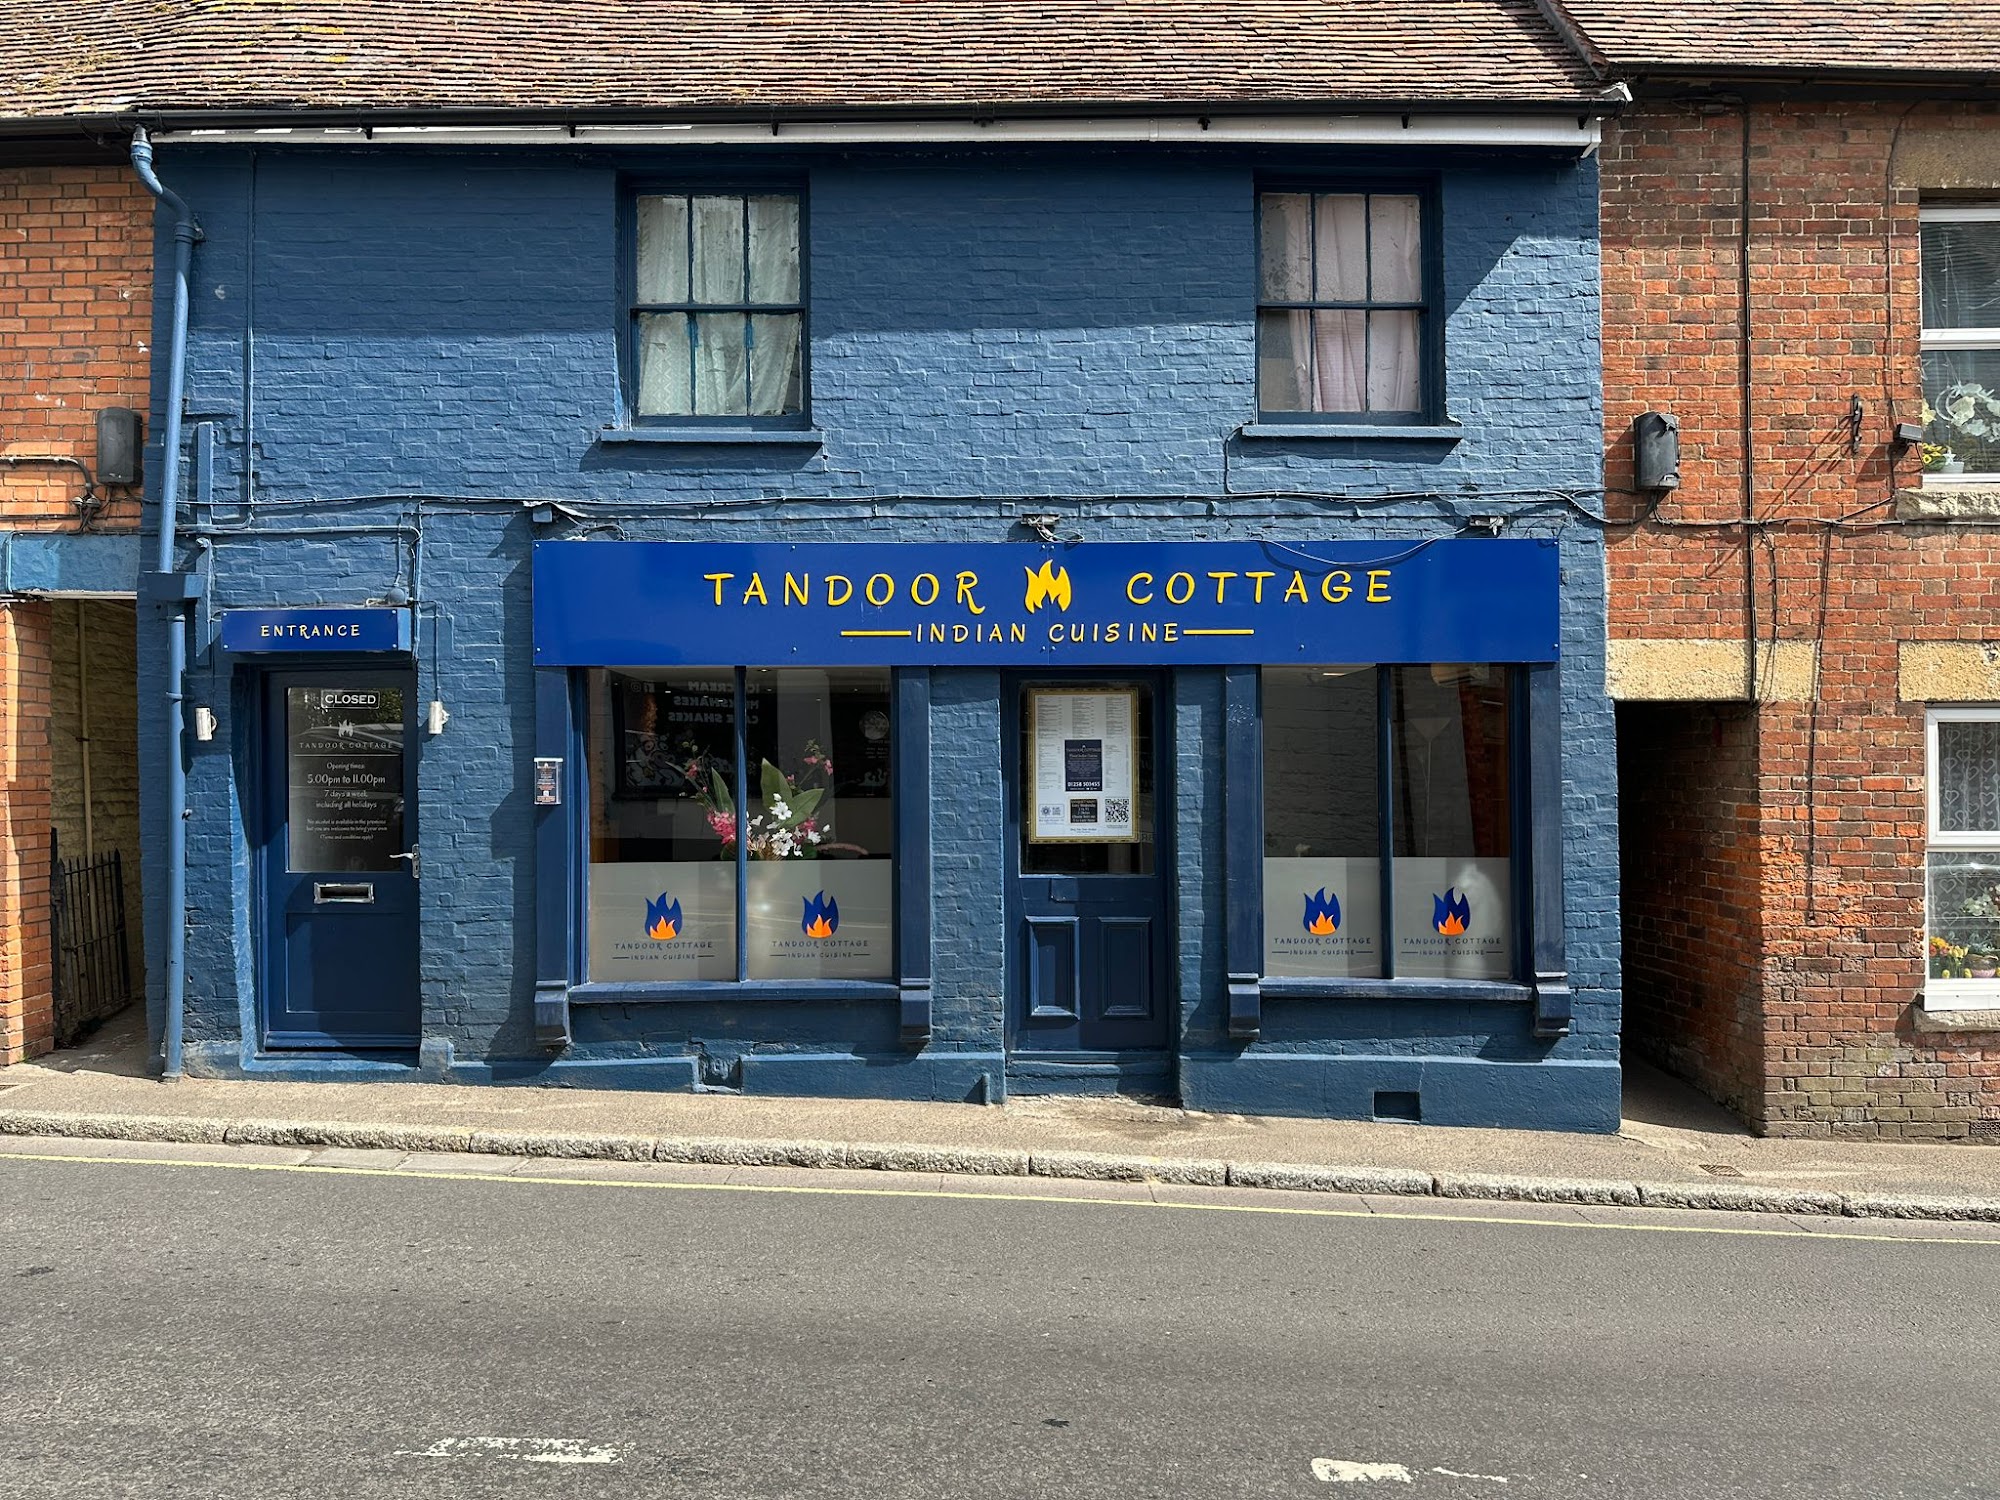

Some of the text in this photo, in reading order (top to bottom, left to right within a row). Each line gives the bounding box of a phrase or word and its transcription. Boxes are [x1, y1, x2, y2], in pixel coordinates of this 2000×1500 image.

[704, 570, 1392, 614] TANDOOR COTTAGE
[261, 624, 360, 639] ENTRANCE
[916, 622, 1180, 643] INDIAN CUISINE
[325, 694, 376, 704] CLOSED
[300, 741, 392, 750] TANDOOR COTTAGE
[326, 761, 350, 771] Opening
[307, 773, 386, 786] 5.00pm to 11.00pm
[324, 790, 330, 798] 7
[330, 790, 345, 800] days
[316, 800, 343, 810] including
[351, 800, 377, 810] holidays
[615, 941, 713, 951] TANDOOR COTTAGE
[772, 940, 868, 949] TANDOOR COTTAGE
[1274, 938, 1321, 946] TANDOOR
[1404, 938, 1451, 946] TANDOOR
